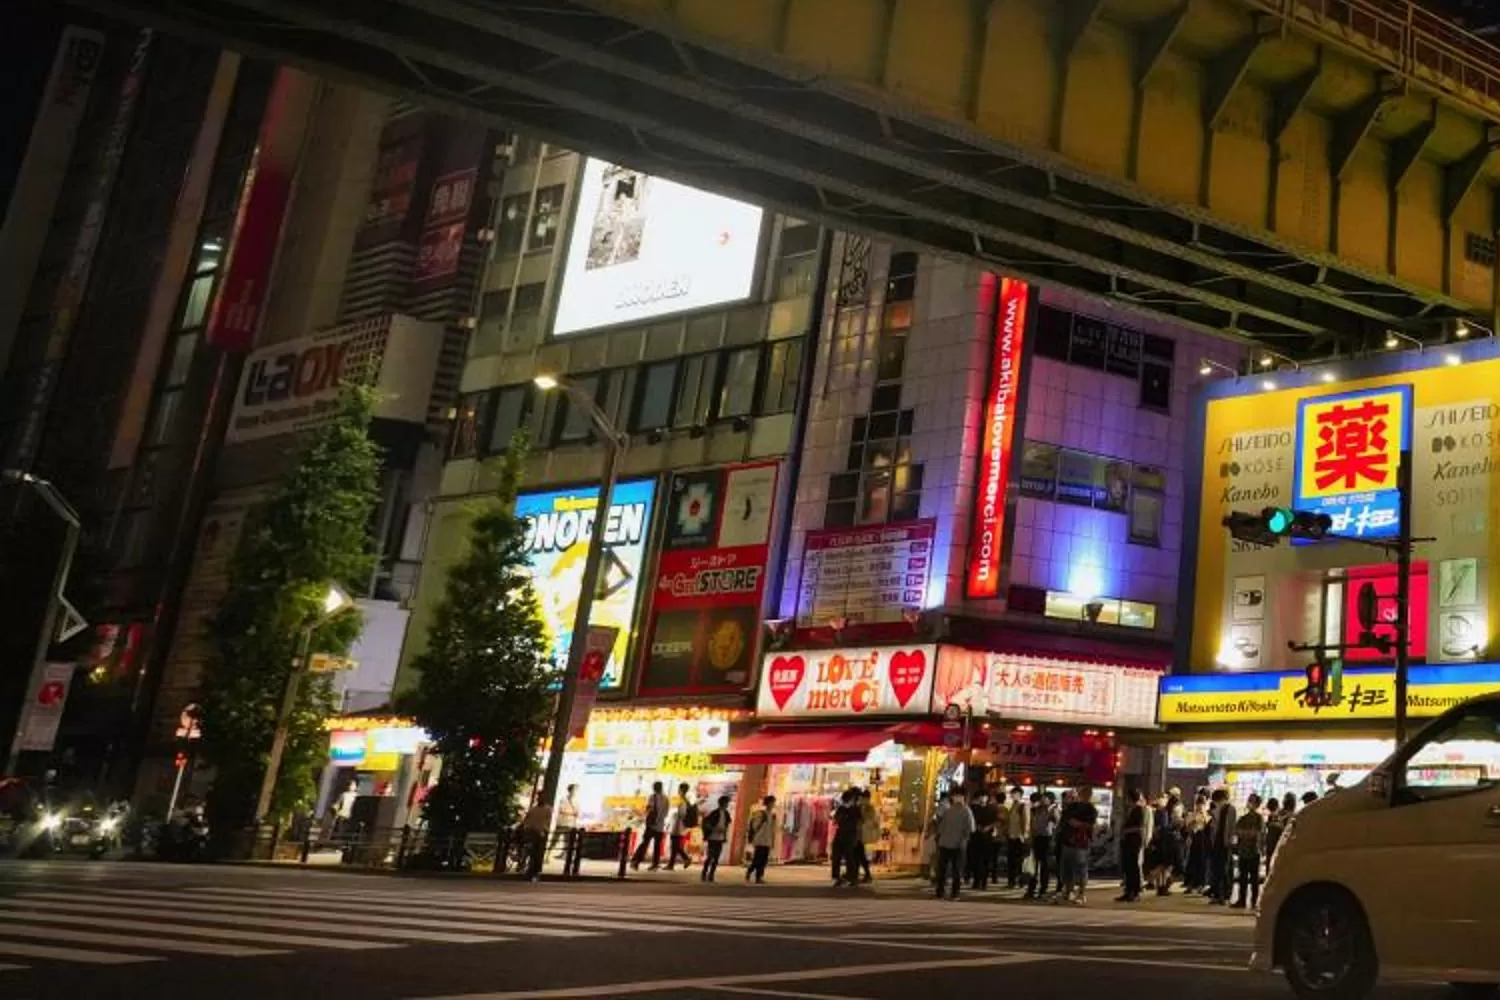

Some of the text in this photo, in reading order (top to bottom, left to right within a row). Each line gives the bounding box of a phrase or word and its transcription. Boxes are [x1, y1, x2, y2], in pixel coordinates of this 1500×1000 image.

[1216, 431, 1292, 455] SHISEIDO
[1314, 401, 1389, 490] 薬
[1219, 482, 1280, 505] Kanebo
[816, 649, 879, 684] LOVE
